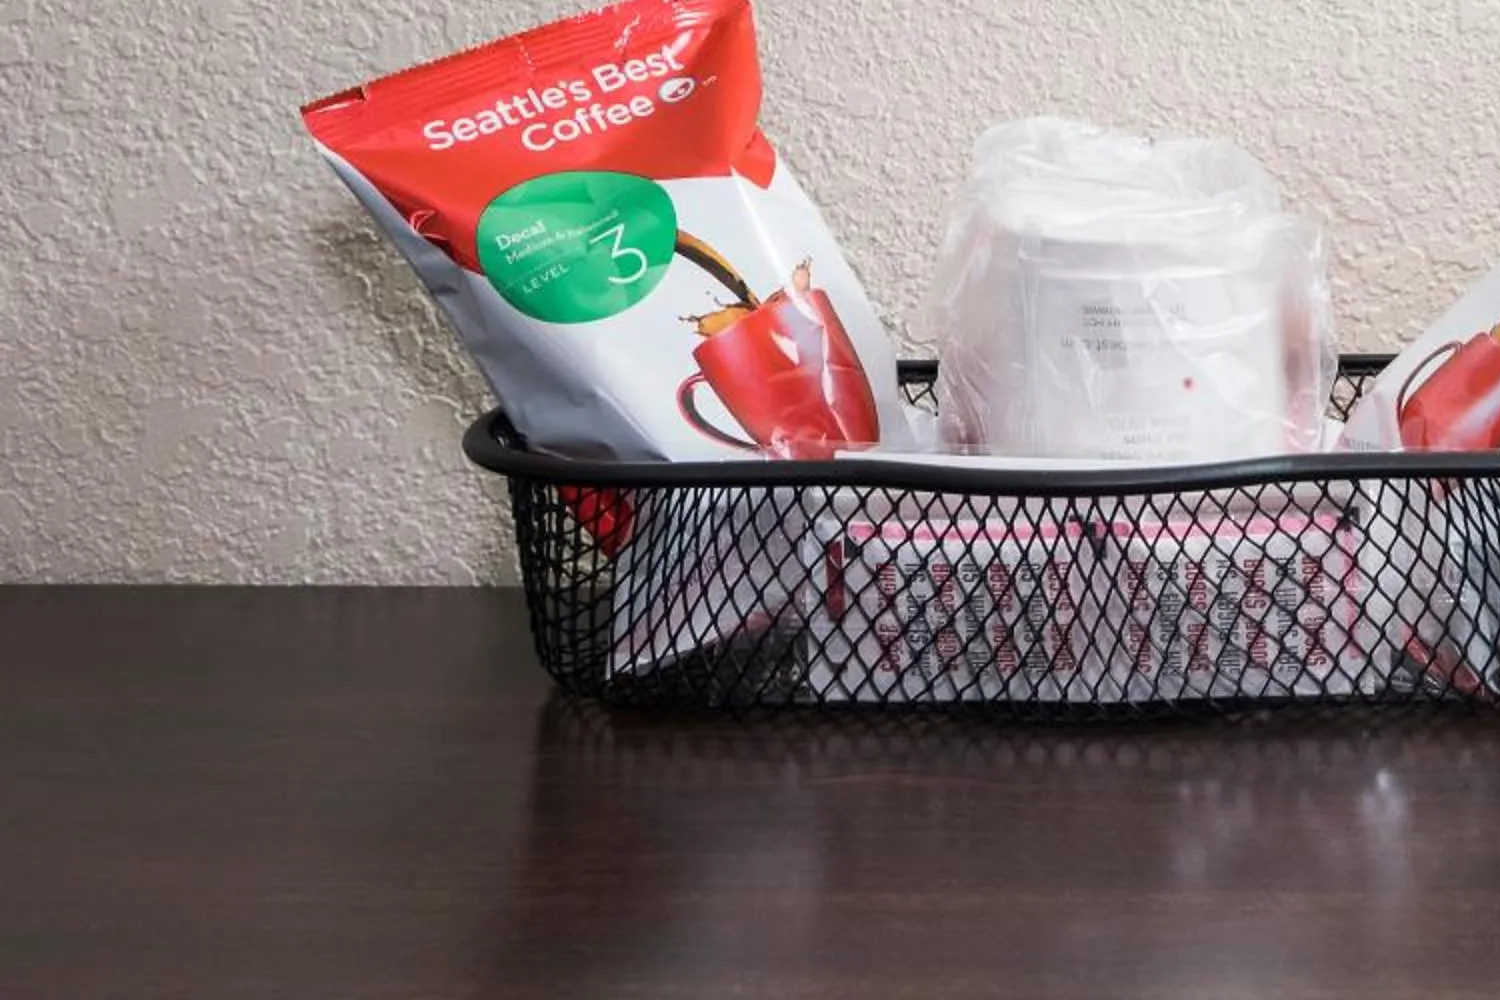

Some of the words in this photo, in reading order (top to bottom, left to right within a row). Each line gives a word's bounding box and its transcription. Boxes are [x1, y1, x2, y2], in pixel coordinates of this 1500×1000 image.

[422, 79, 592, 150] Seattle's
[591, 41, 685, 93] Best
[520, 94, 655, 151] Coffee
[522, 263, 570, 295] LEVEL
[588, 223, 647, 285] 3
